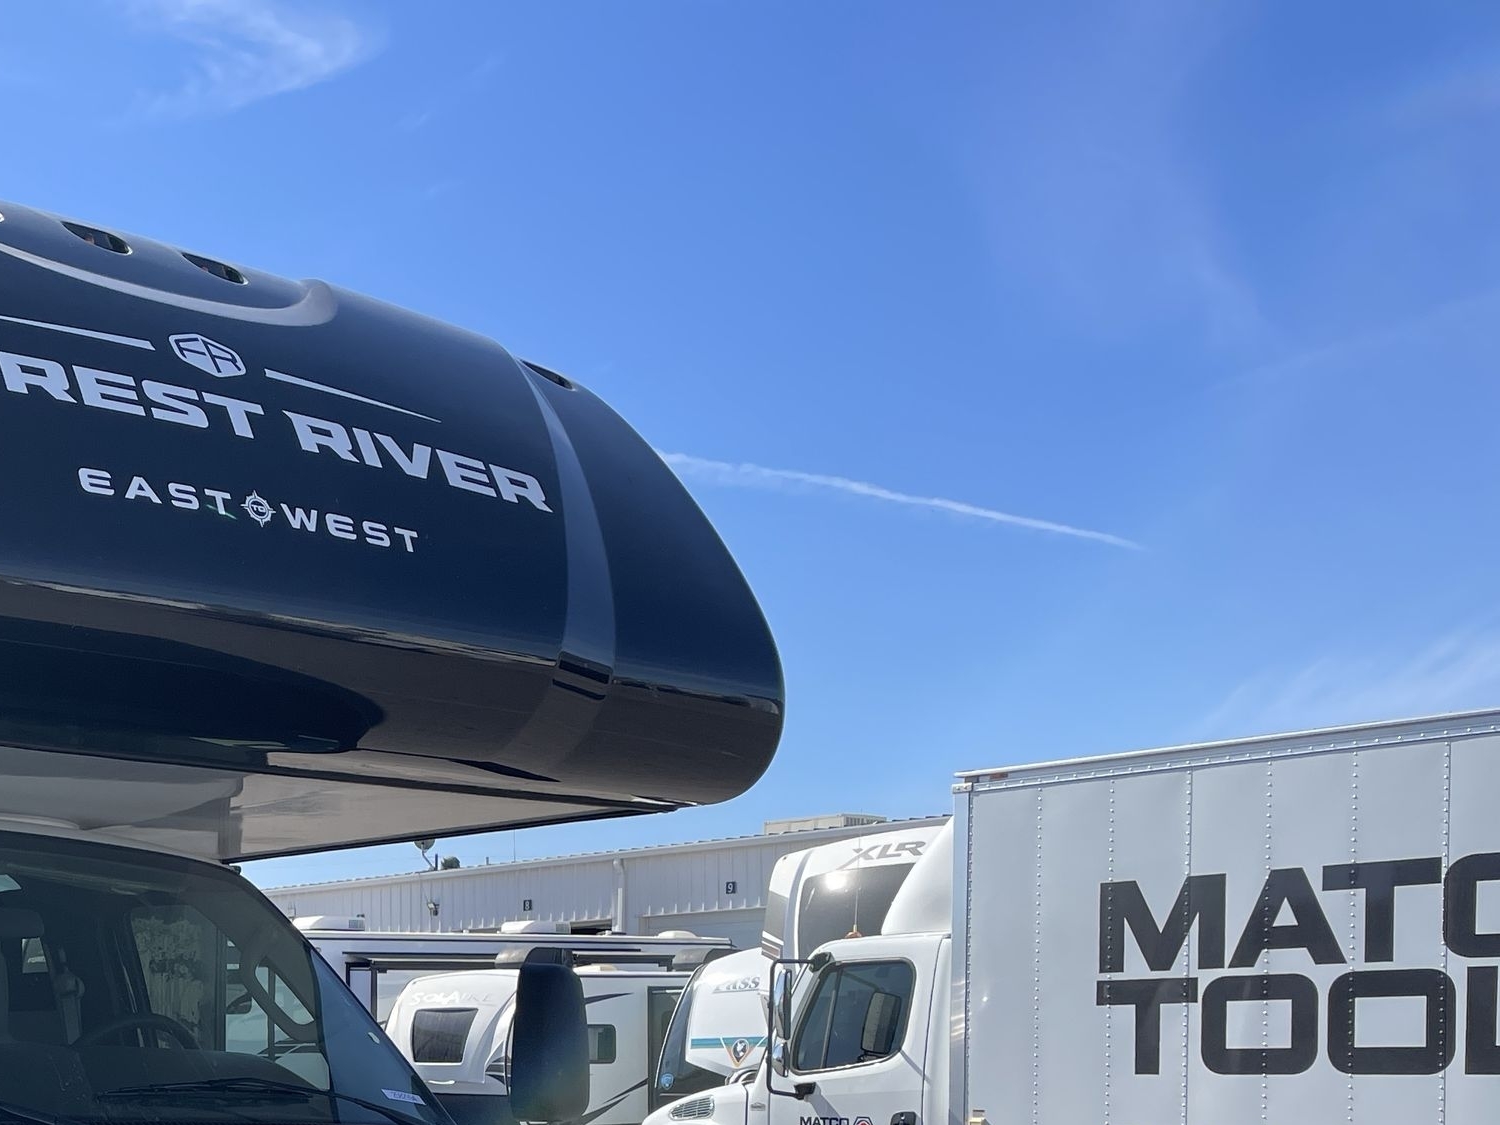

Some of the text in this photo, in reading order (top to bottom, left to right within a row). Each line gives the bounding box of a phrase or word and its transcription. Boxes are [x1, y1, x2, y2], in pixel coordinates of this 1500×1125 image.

[282, 411, 554, 513] RIVER
[77, 467, 232, 515] EAST
[278, 502, 418, 553] WEST
[838, 840, 927, 870] XLR
